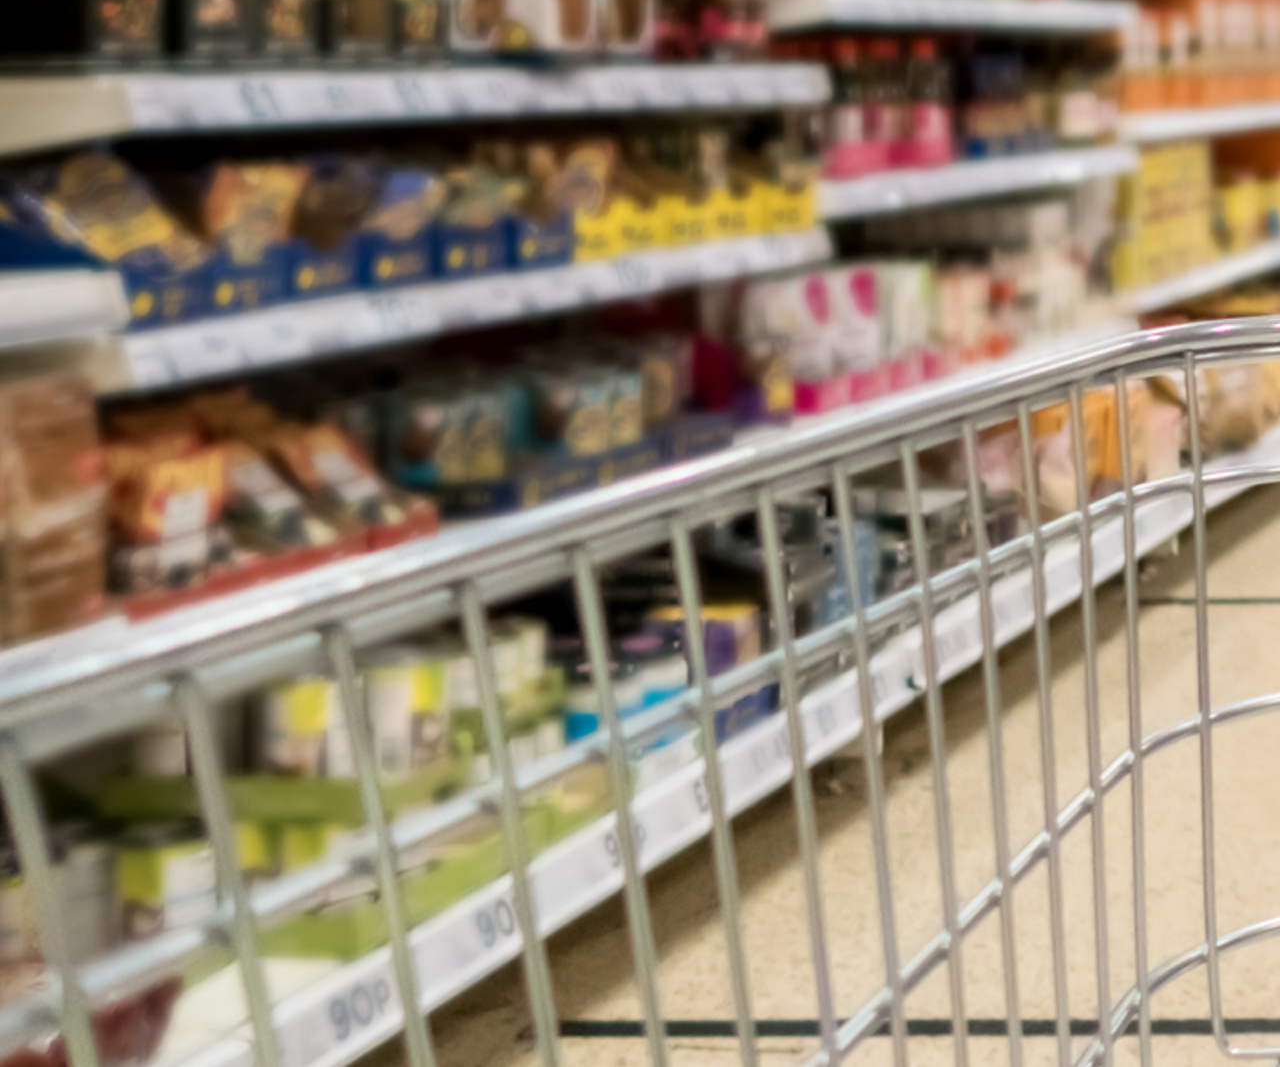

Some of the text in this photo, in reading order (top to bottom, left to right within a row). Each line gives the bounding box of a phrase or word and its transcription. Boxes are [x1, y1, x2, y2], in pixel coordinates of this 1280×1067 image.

[239, 81, 282, 120] £1
[475, 898, 516, 949] 90
[328, 978, 391, 1042] 90p
